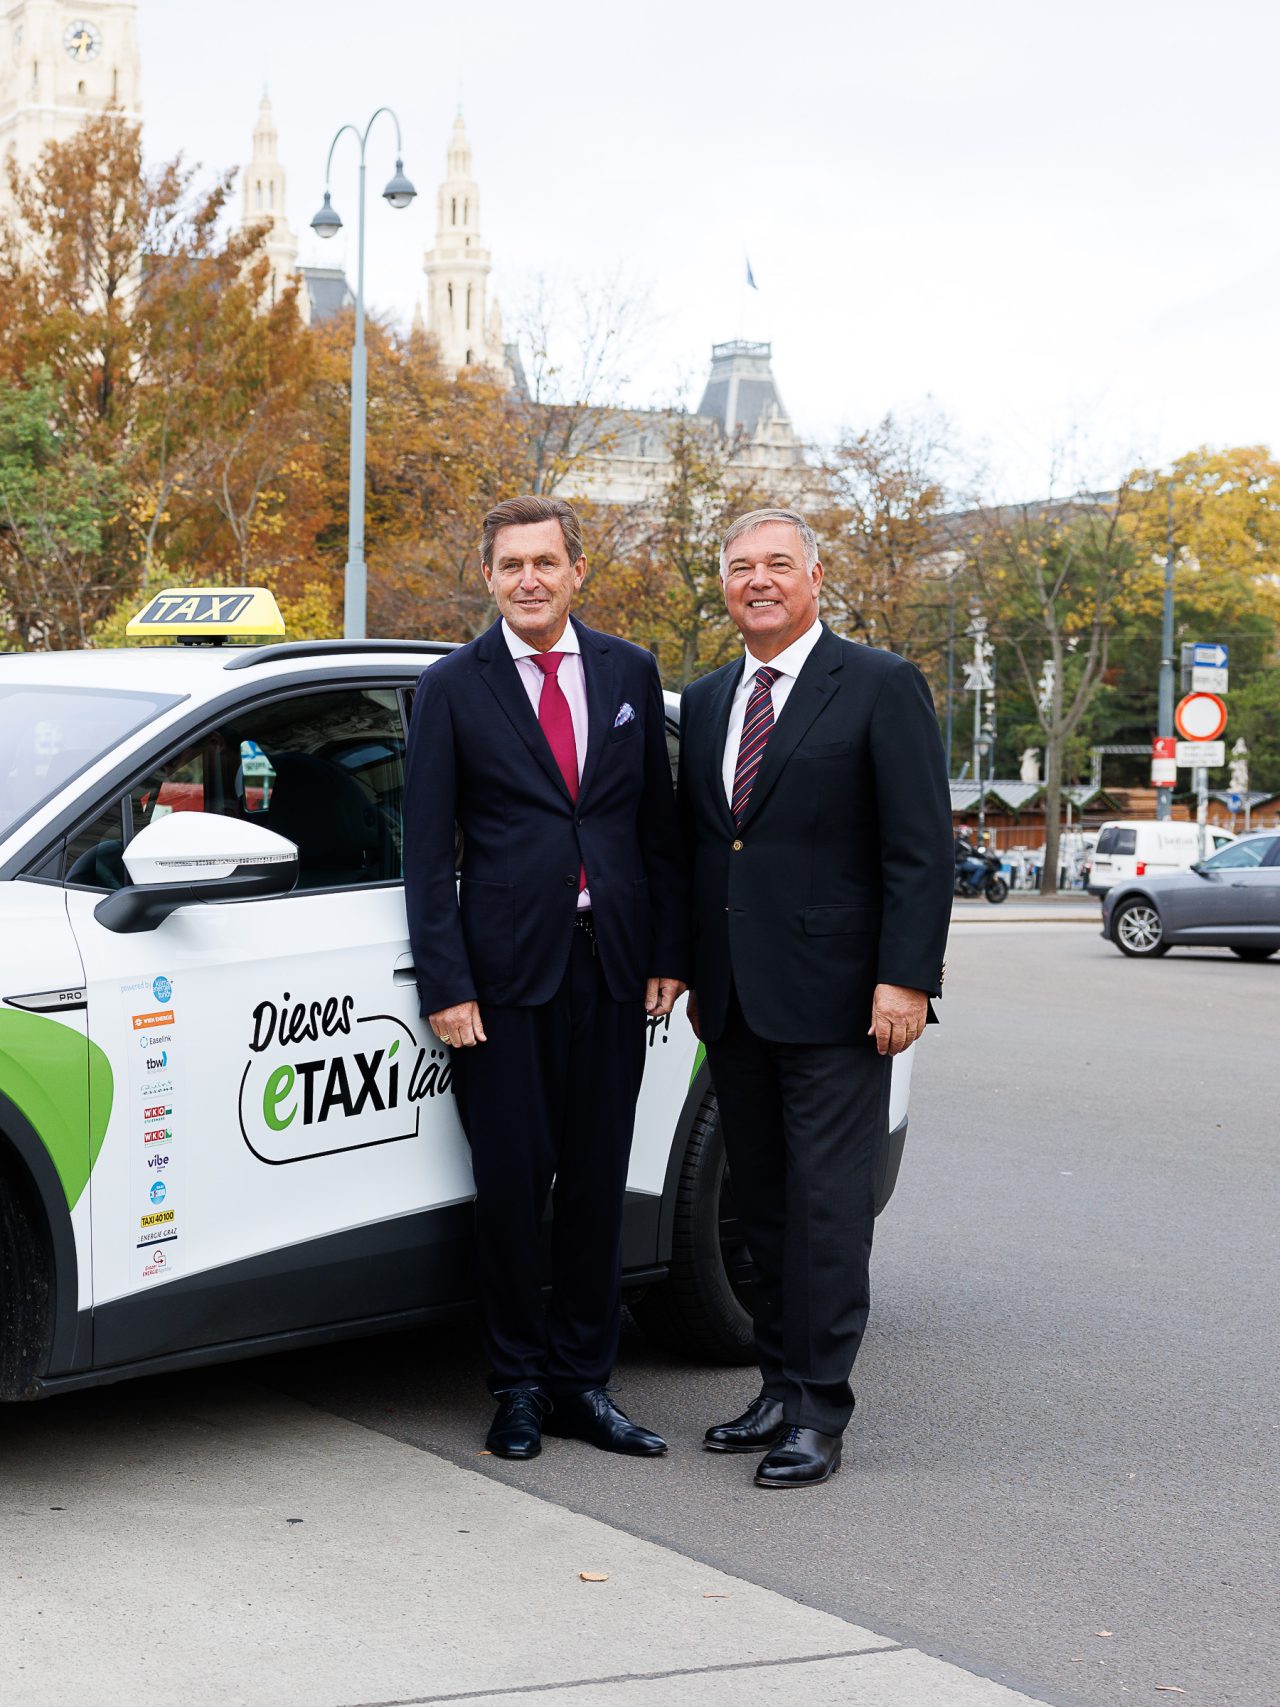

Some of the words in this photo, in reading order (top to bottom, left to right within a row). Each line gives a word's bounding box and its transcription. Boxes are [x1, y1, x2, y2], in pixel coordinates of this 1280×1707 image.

[152, 597, 251, 621] TAXI
[59, 992, 82, 1001] PRO
[248, 992, 354, 1052] Dieses
[149, 1035, 171, 1045] Easelink
[146, 1058, 163, 1069] tbw
[145, 1107, 165, 1118] WKO
[145, 1130, 165, 1142] WKO
[148, 1154, 169, 1168] vibe
[141, 1216, 155, 1226] TAXI
